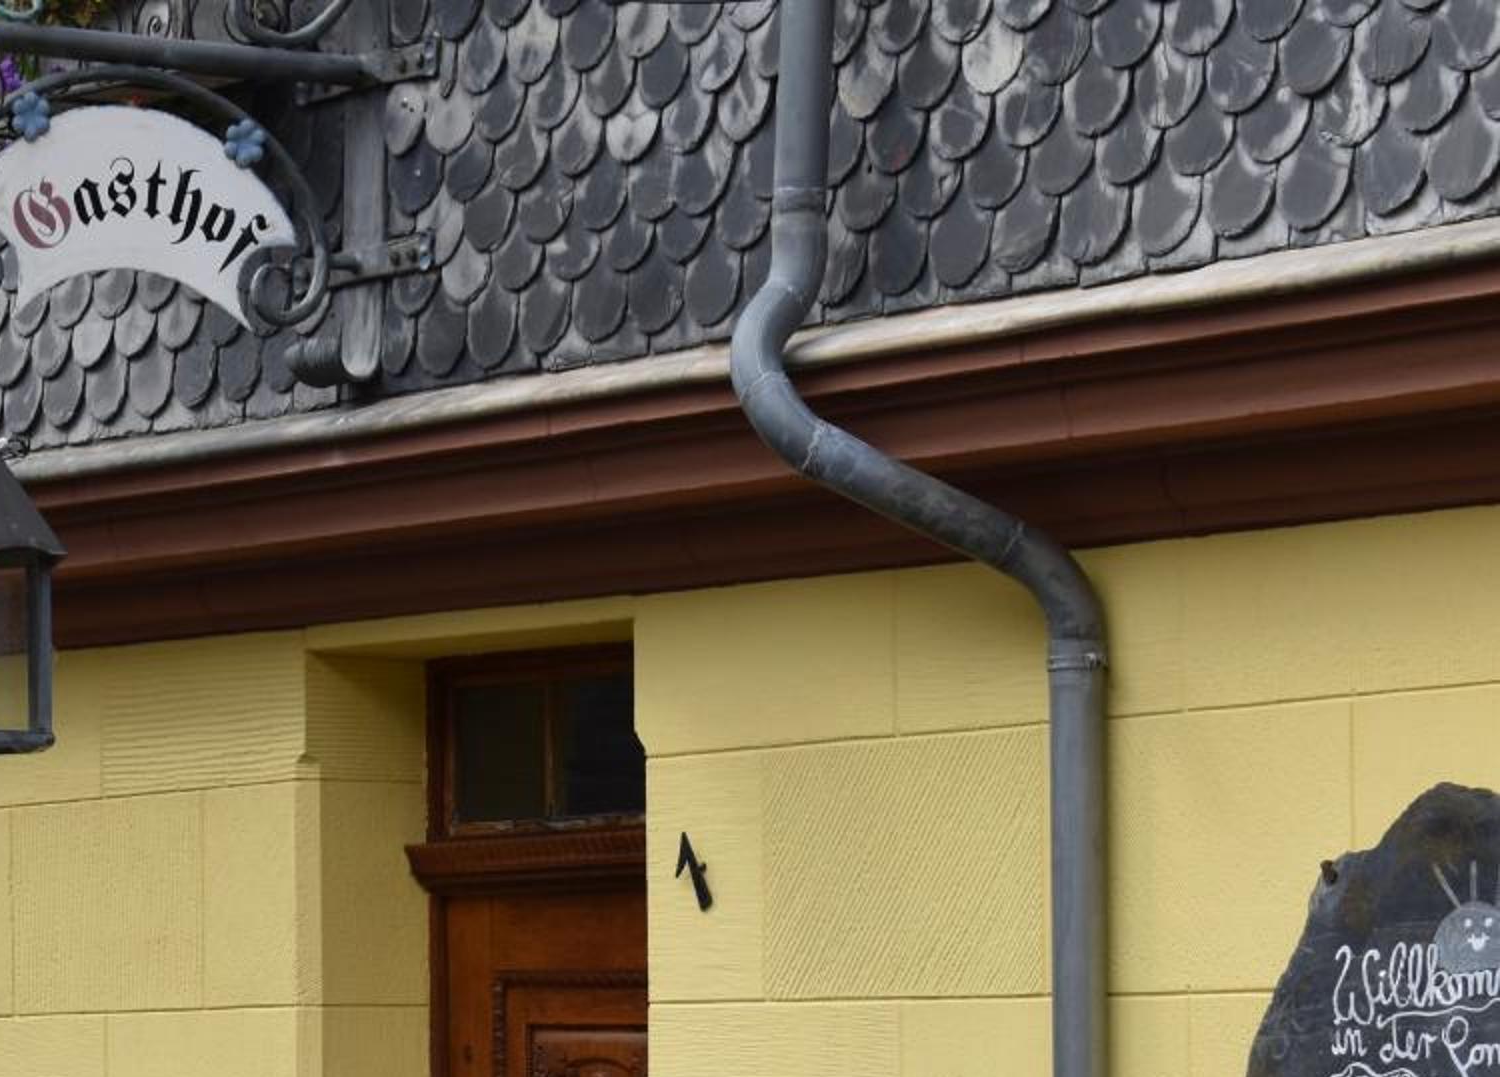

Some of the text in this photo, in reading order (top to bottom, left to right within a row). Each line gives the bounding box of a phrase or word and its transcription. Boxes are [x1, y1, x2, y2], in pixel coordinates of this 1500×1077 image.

[13, 157, 271, 273] Gasthof
[1331, 1027, 1367, 1056] in
[1378, 1014, 1437, 1063] der
